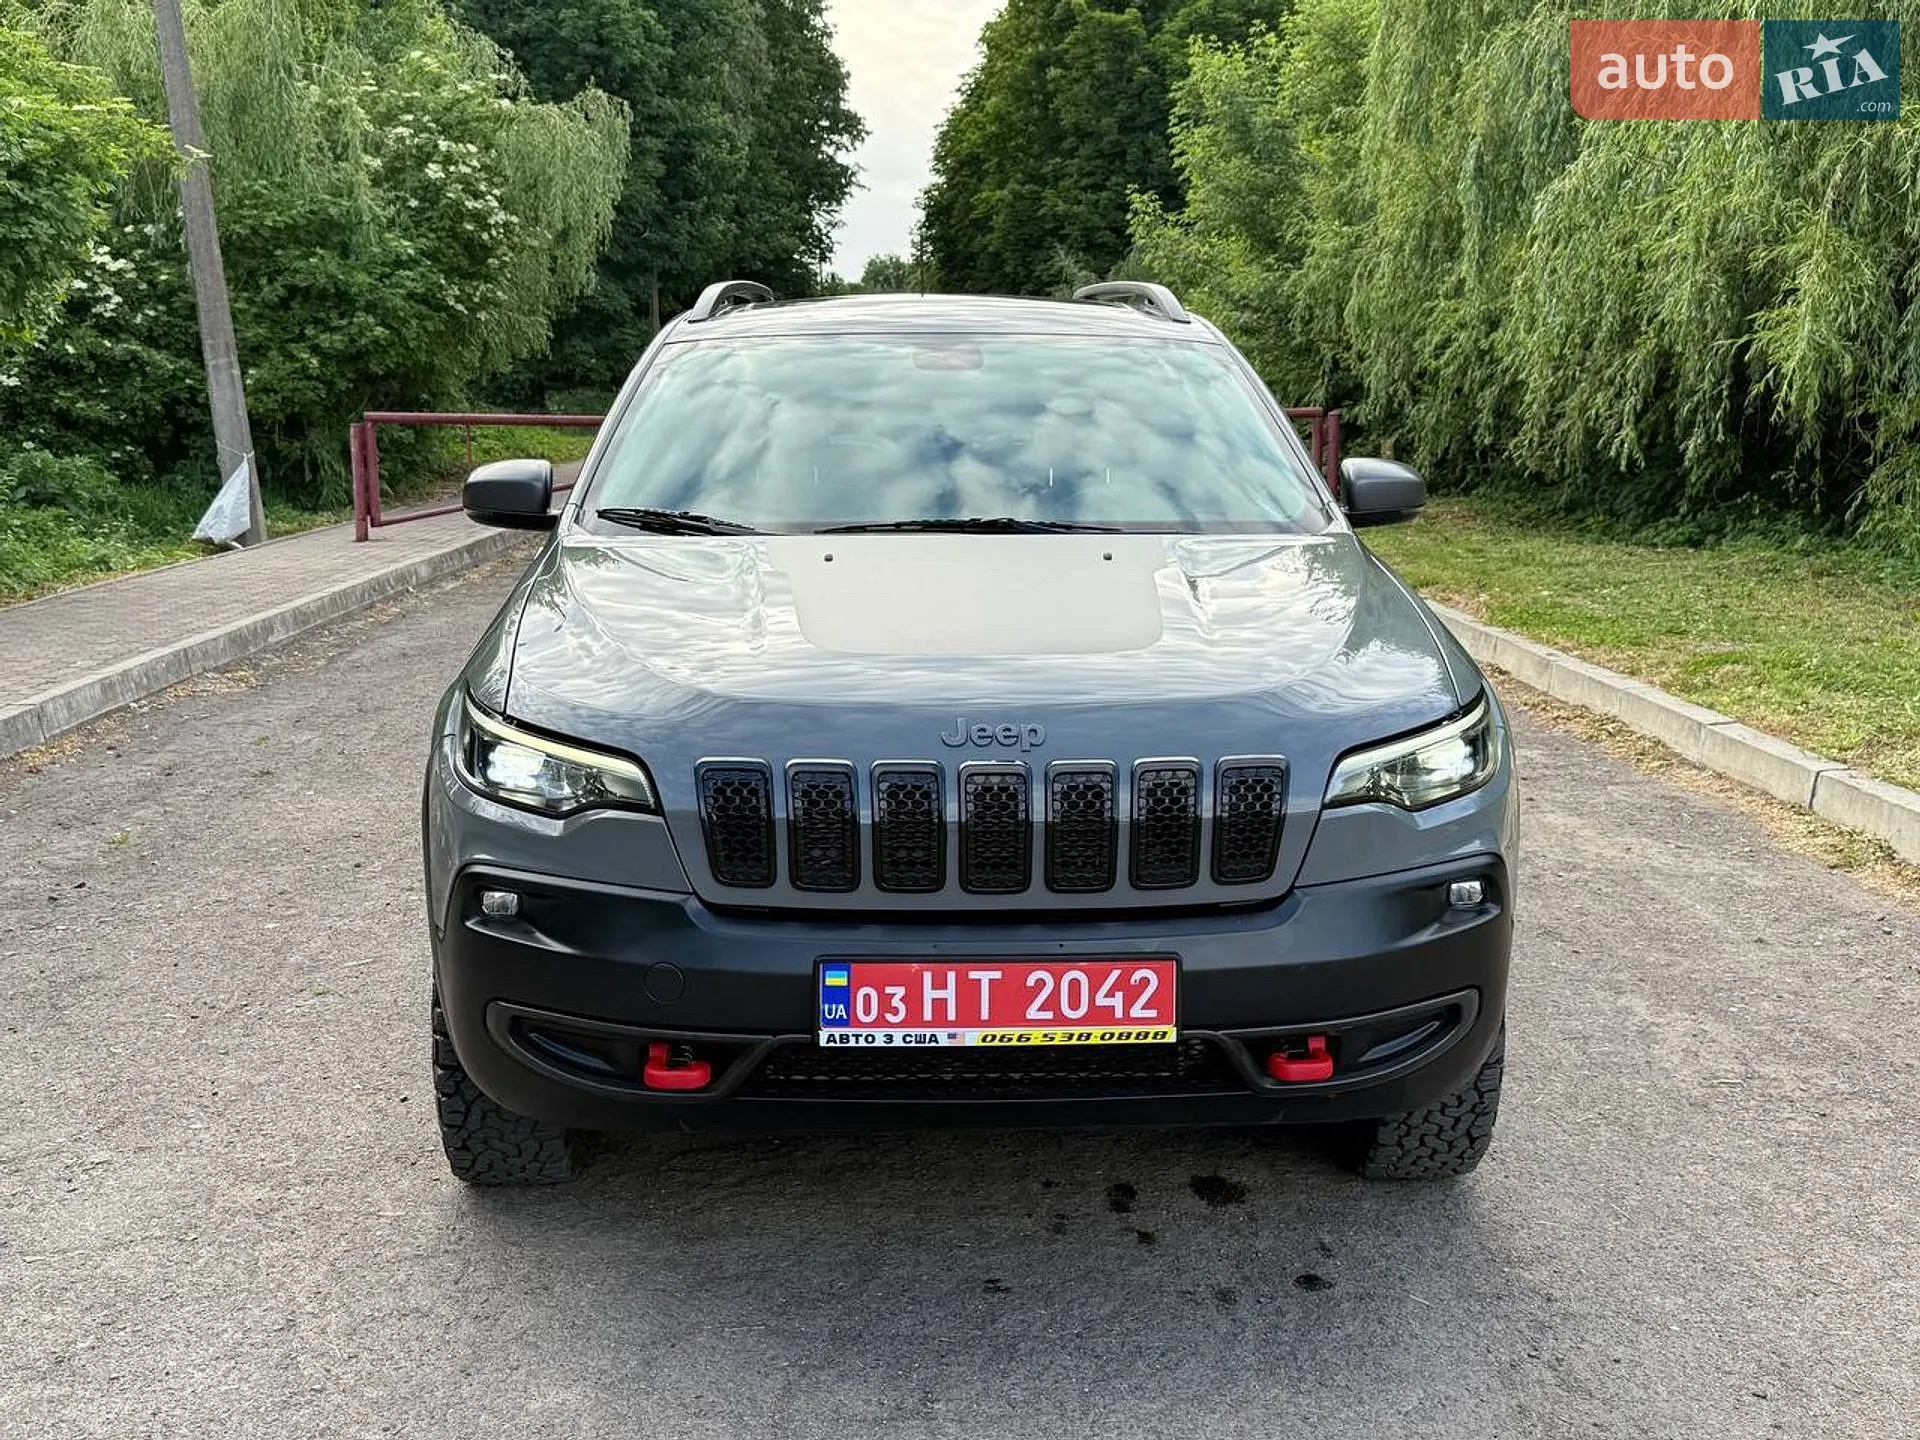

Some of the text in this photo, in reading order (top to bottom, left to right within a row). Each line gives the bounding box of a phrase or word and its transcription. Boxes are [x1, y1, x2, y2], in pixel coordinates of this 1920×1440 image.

[940, 717, 1046, 752] Jeep
[855, 968, 1159, 1023] 03 HT 2042
[824, 1003, 847, 1020] UA
[825, 1034, 876, 1045] АВТО
[902, 1034, 940, 1045] США
